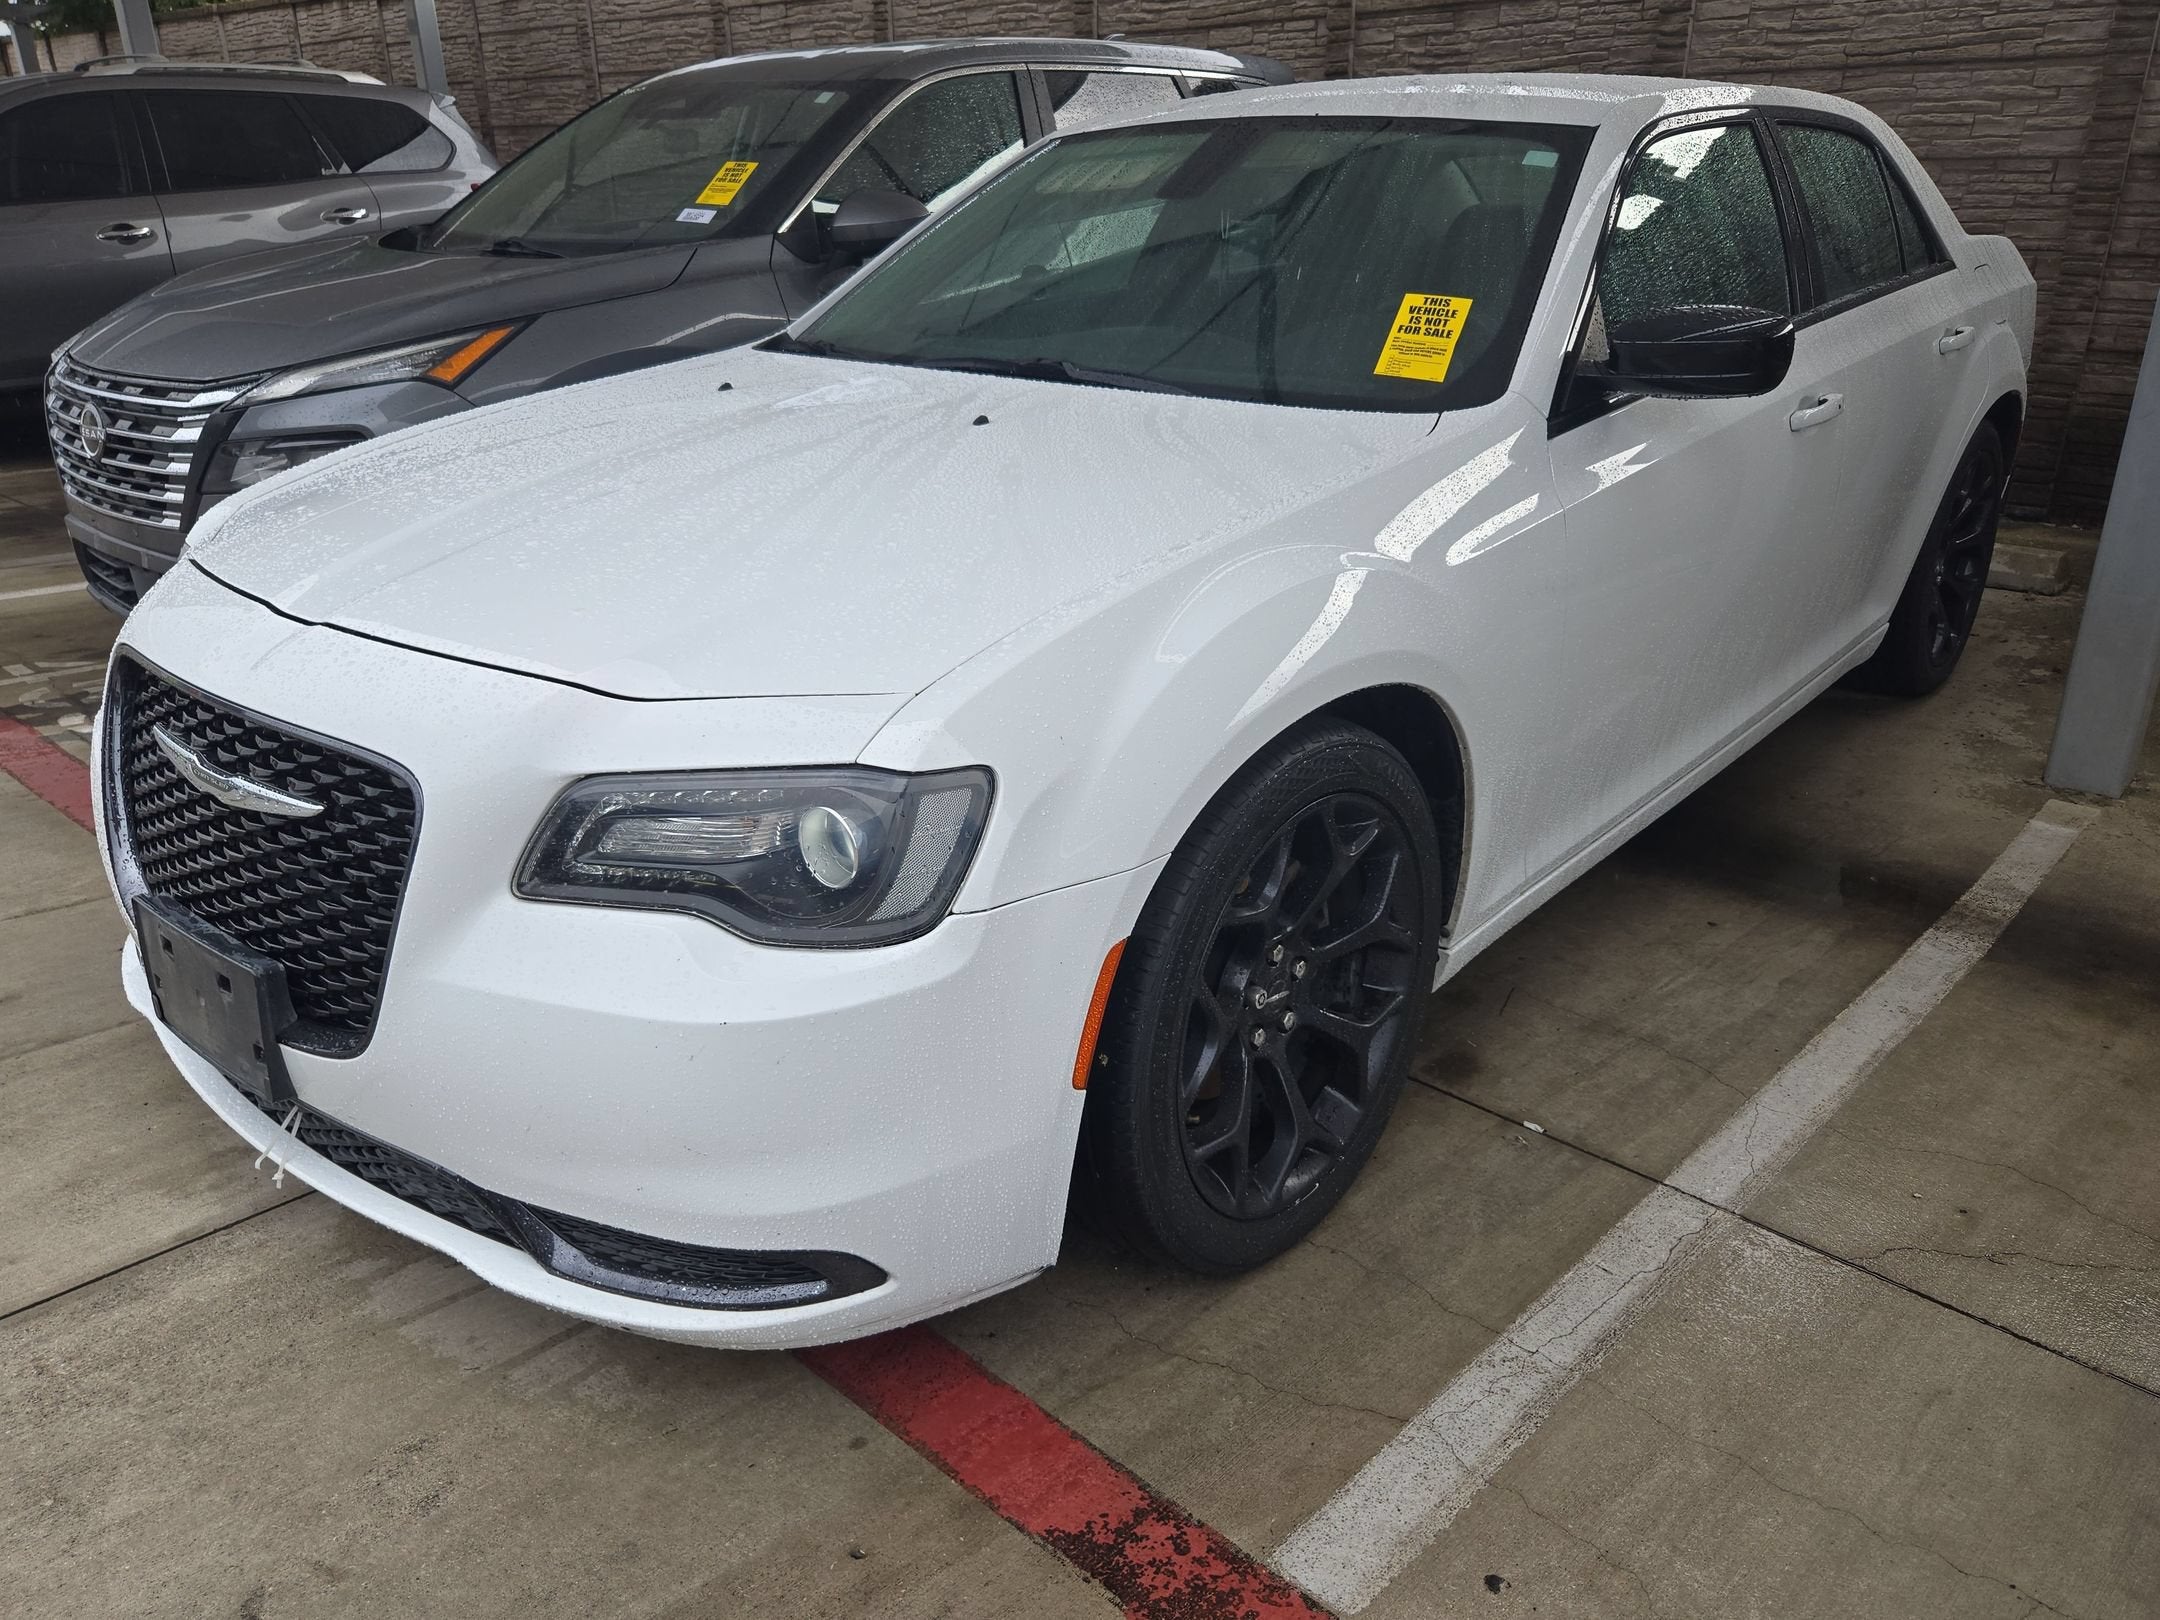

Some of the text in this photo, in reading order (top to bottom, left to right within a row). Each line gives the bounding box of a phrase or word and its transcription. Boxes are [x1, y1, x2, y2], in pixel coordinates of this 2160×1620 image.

[1423, 297, 1451, 307] THIS
[1408, 305, 1458, 318] VEHICLE
[1409, 316, 1450, 328] IS NOT
[1397, 324, 1453, 338] FOR SALE
